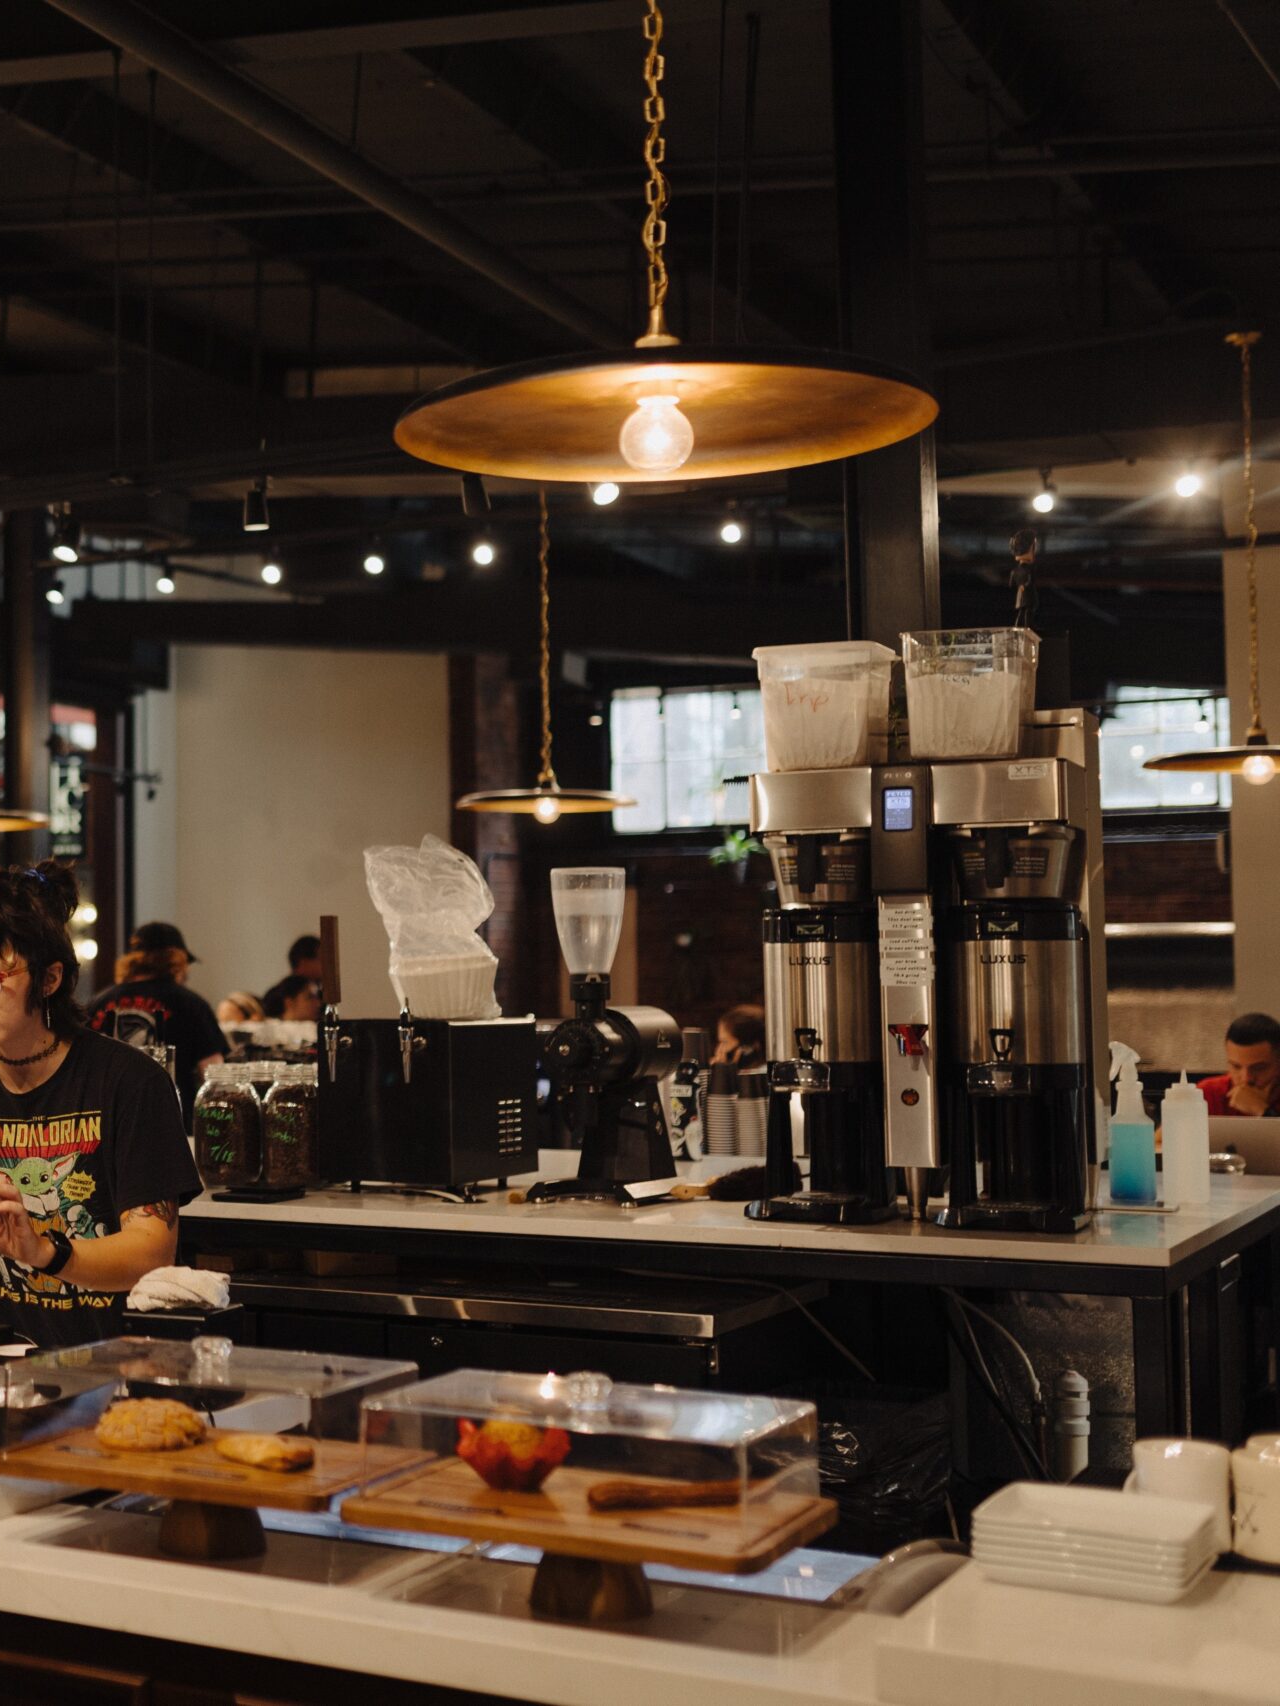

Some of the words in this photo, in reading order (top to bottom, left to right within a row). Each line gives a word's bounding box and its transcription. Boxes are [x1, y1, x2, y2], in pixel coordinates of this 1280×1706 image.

[1013, 764, 1042, 775] XTS
[789, 955, 832, 966] LUXUS
[980, 953, 1028, 965] LUXUS
[25, 1292, 39, 1305] IS
[41, 1297, 73, 1310] THE
[77, 1294, 115, 1308] WAY
